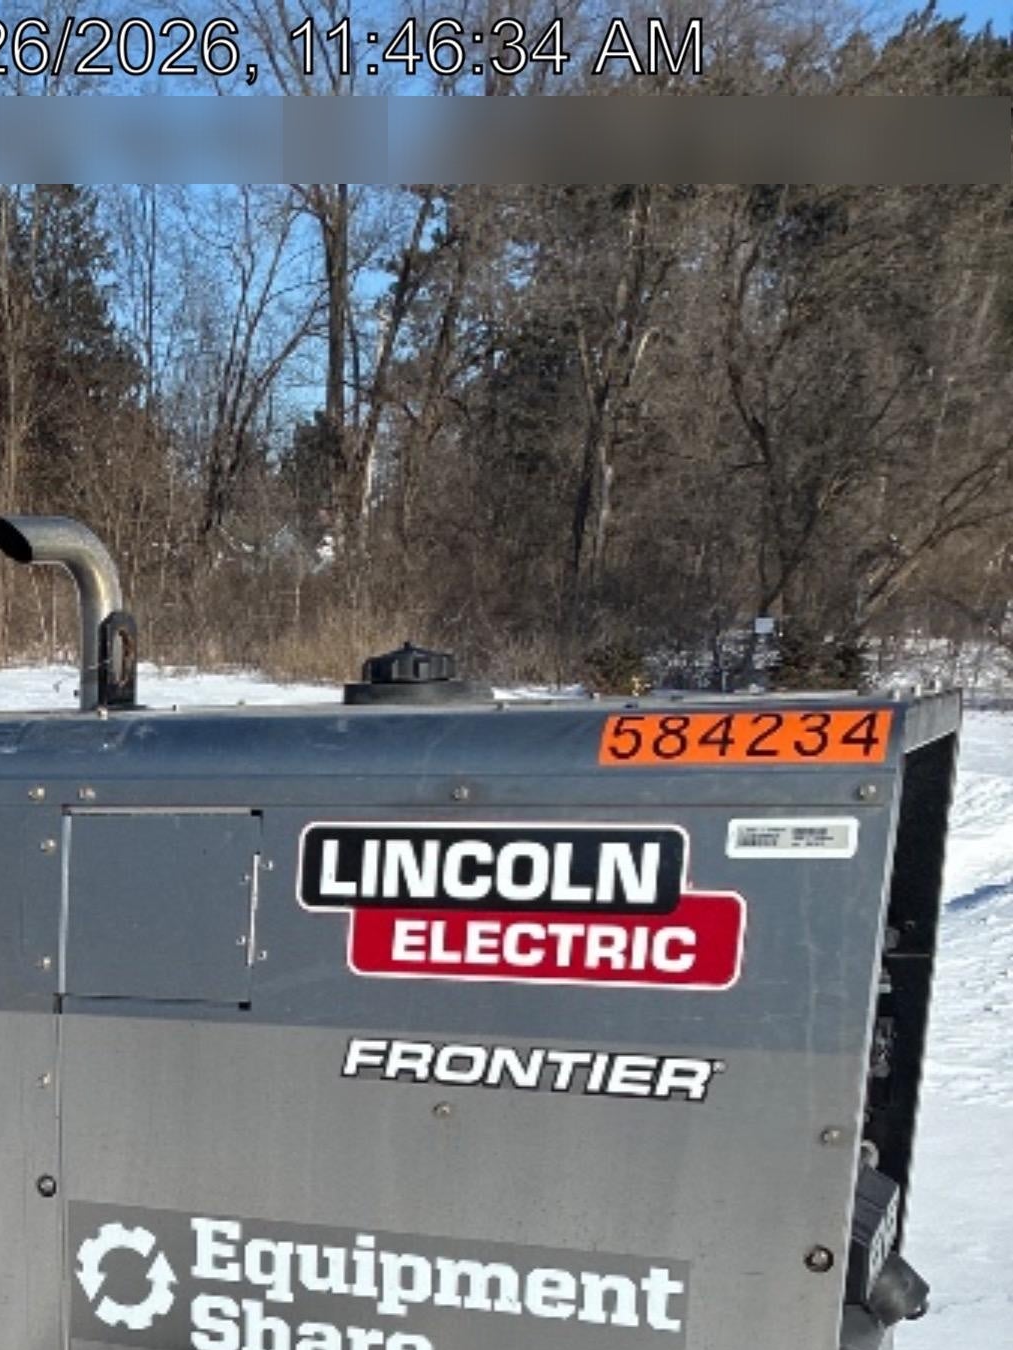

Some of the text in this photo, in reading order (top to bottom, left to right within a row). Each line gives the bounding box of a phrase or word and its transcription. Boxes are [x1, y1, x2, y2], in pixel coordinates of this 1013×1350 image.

[607, 712, 881, 759] 584234
[318, 839, 661, 903] LINCOLN
[390, 918, 697, 973] ELECTRIC
[189, 1216, 684, 1333] Equipment
